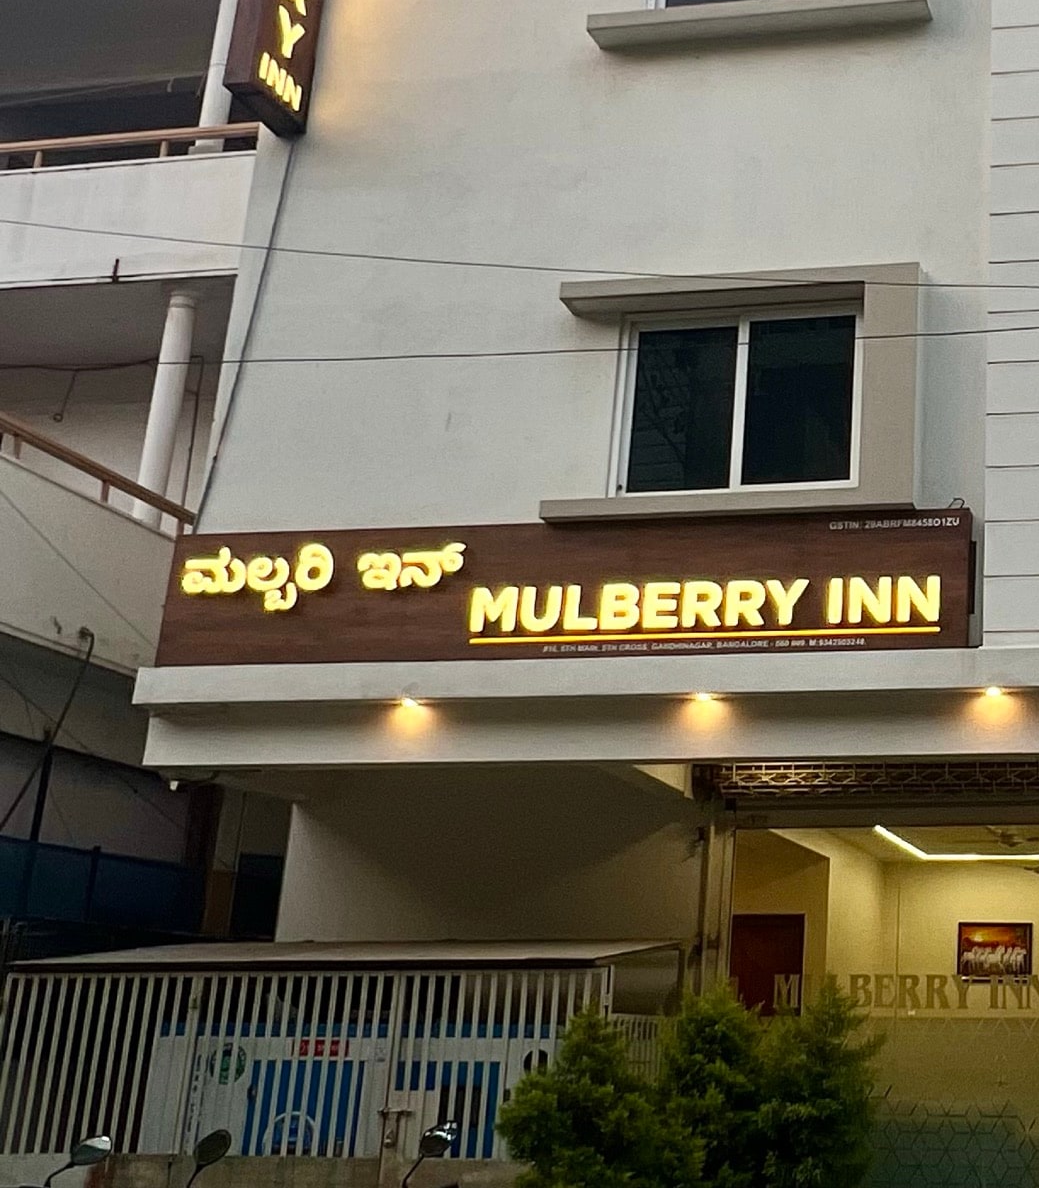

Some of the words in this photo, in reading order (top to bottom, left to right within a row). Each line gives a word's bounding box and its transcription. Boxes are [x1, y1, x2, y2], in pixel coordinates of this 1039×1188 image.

[258, 51, 303, 112] INN
[357, 542, 467, 591] ಇನ್
[469, 578, 810, 633] MULBERRY
[826, 575, 942, 625] INN
[716, 640, 769, 649] BANGALORE
[773, 973, 972, 1010] MBERRY
